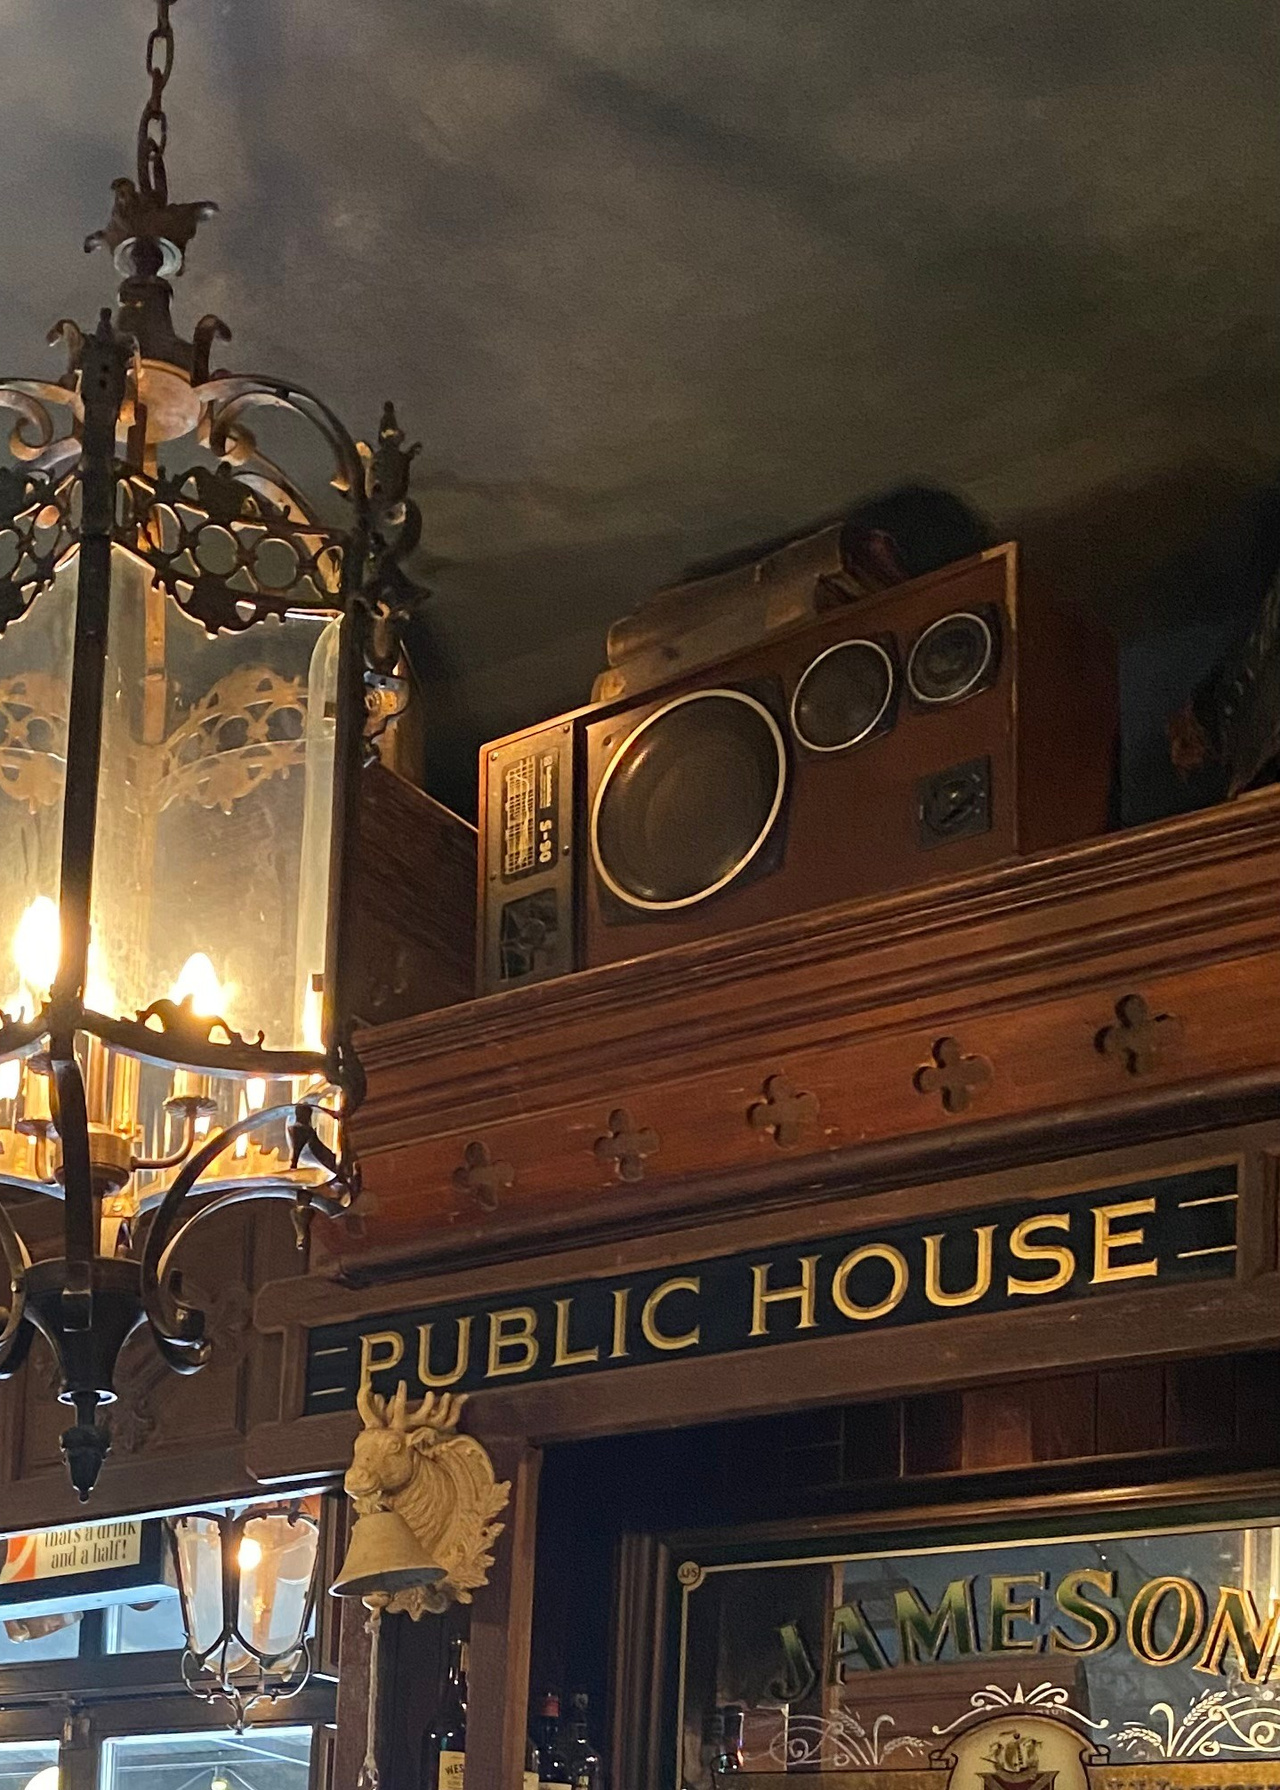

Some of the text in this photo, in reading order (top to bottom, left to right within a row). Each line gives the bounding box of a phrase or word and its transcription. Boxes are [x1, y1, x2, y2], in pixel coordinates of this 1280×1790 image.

[358, 1197, 1160, 1387] PUBLIC HOUSE
[51, 1539, 127, 1569] and a half!
[762, 1568, 1280, 1698] JAMESON
